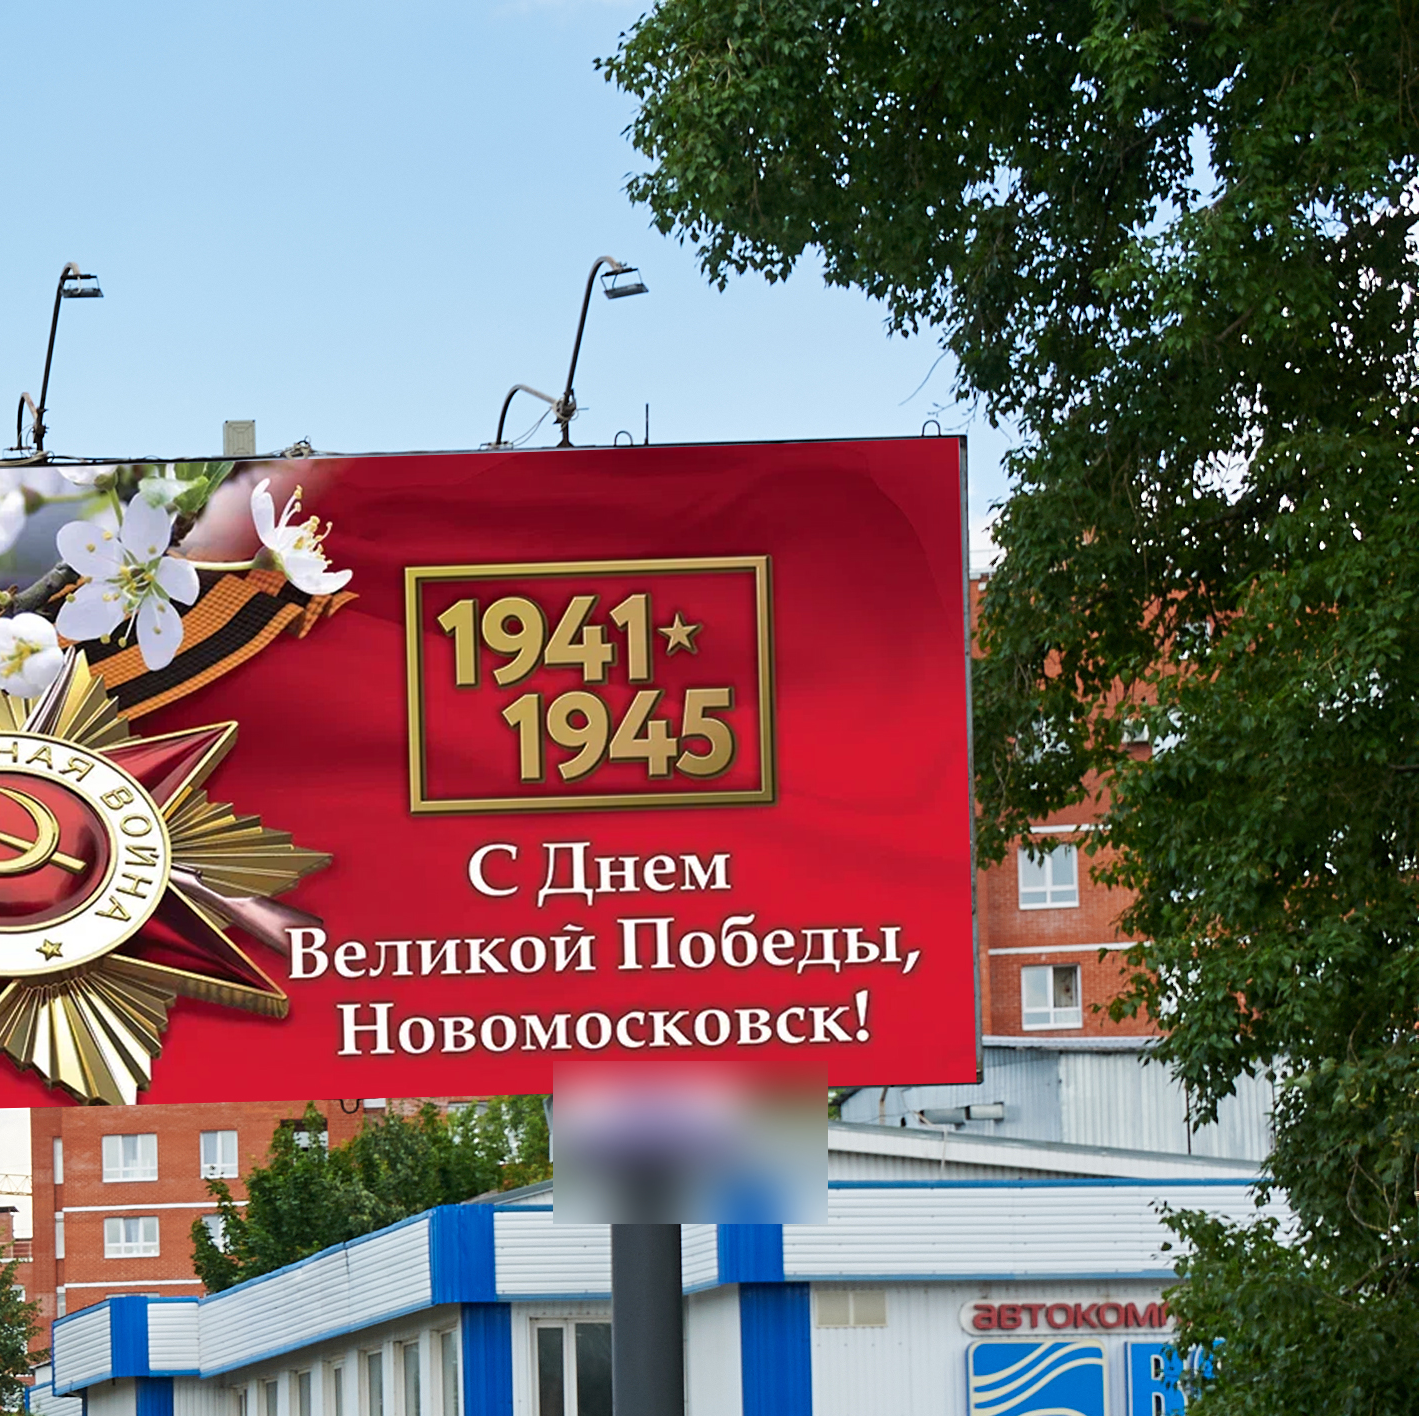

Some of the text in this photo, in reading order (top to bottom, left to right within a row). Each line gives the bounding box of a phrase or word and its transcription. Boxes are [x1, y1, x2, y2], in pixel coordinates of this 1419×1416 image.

[437, 593, 652, 687] 1941
[501, 687, 736, 783] 1945
[467, 841, 732, 907] С Днем
[284, 913, 922, 980] Великой Победы,
[335, 990, 872, 1057] Новомосковск!
